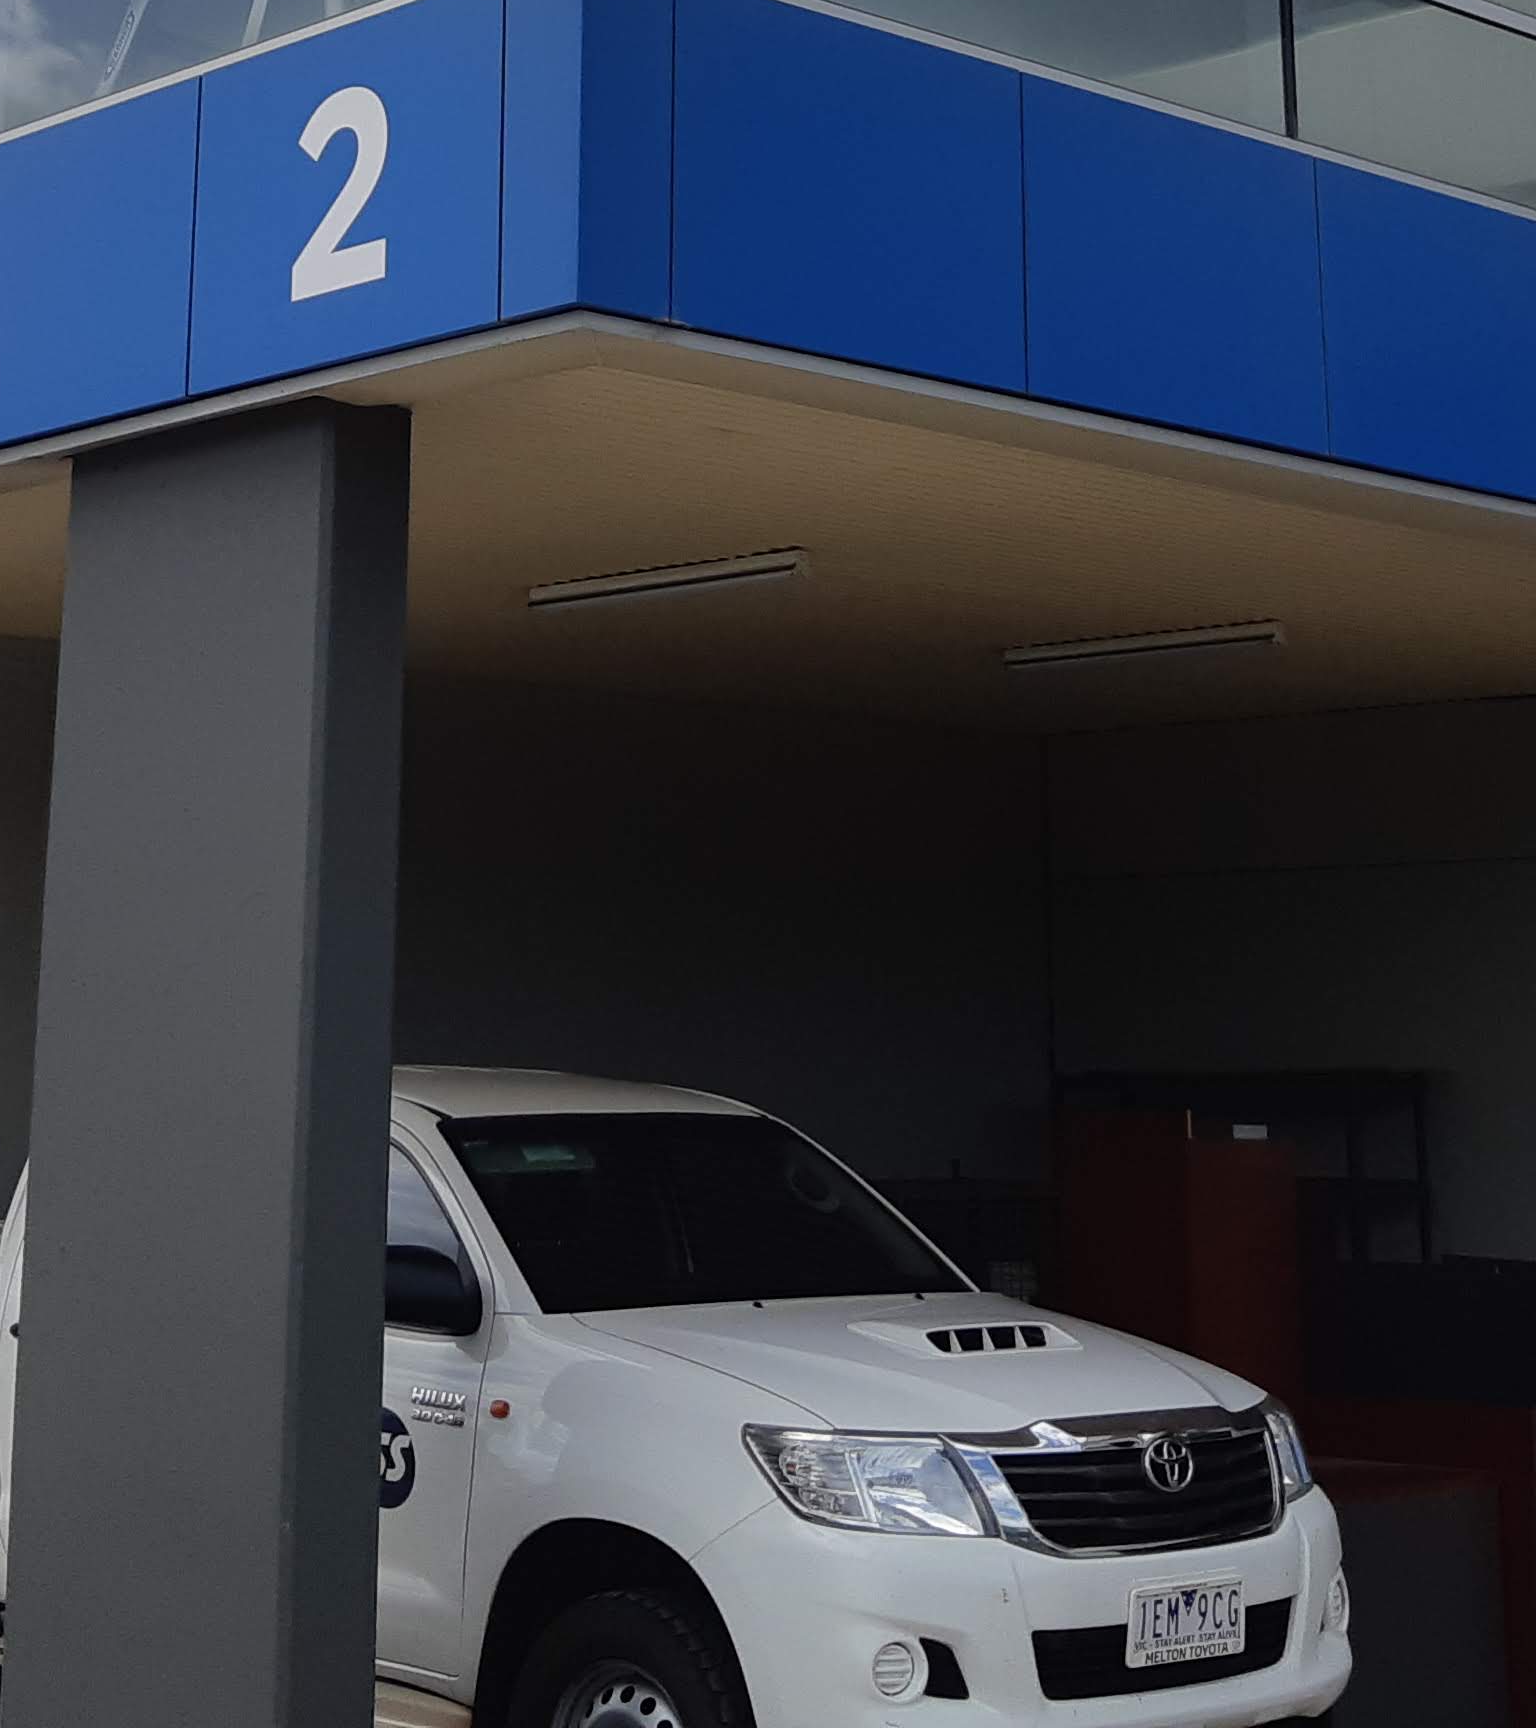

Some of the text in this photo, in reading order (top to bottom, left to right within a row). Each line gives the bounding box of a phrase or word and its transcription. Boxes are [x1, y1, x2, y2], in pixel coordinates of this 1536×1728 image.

[291, 86, 389, 303] 2
[411, 1386, 466, 1409] HILUX
[1145, 1642, 1229, 1665] MELTON TOYOTA
